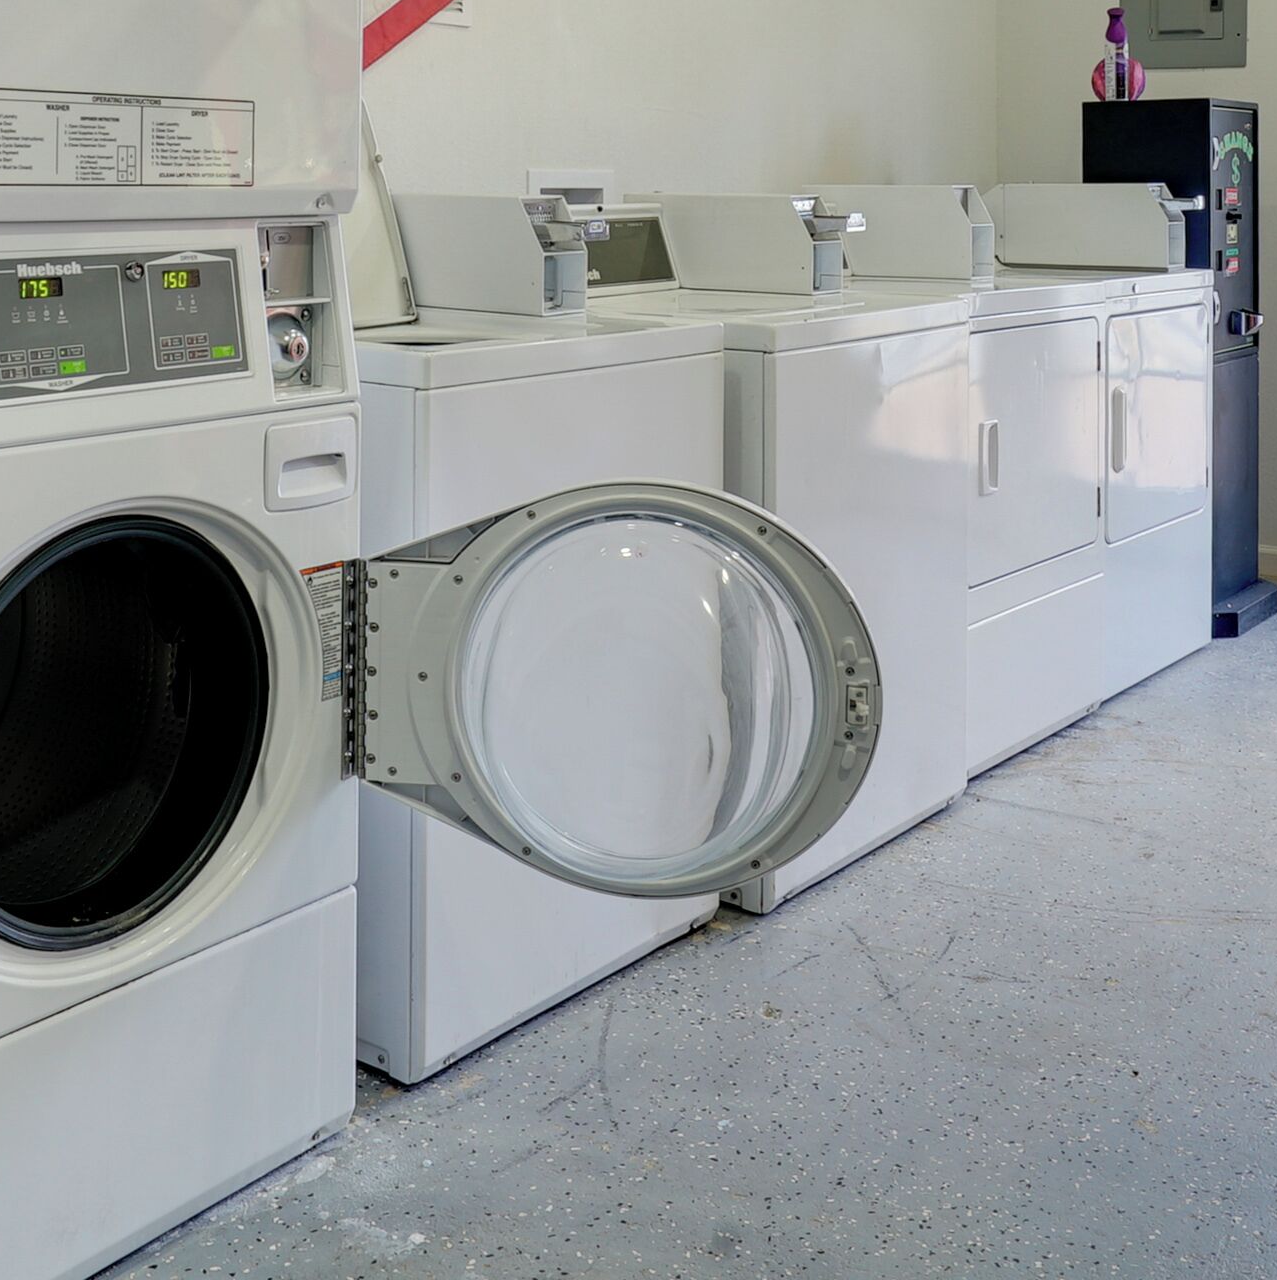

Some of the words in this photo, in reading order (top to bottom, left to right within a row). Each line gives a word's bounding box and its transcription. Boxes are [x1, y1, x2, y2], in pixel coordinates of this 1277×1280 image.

[92, 96, 123, 104] OPERATING
[124, 98, 162, 106] INSTRUCTIONS
[17, 262, 82, 278] Huebsch
[164, 272, 187, 289] 150
[23, 280, 49, 298] 175
[48, 380, 74, 388] WASHER
